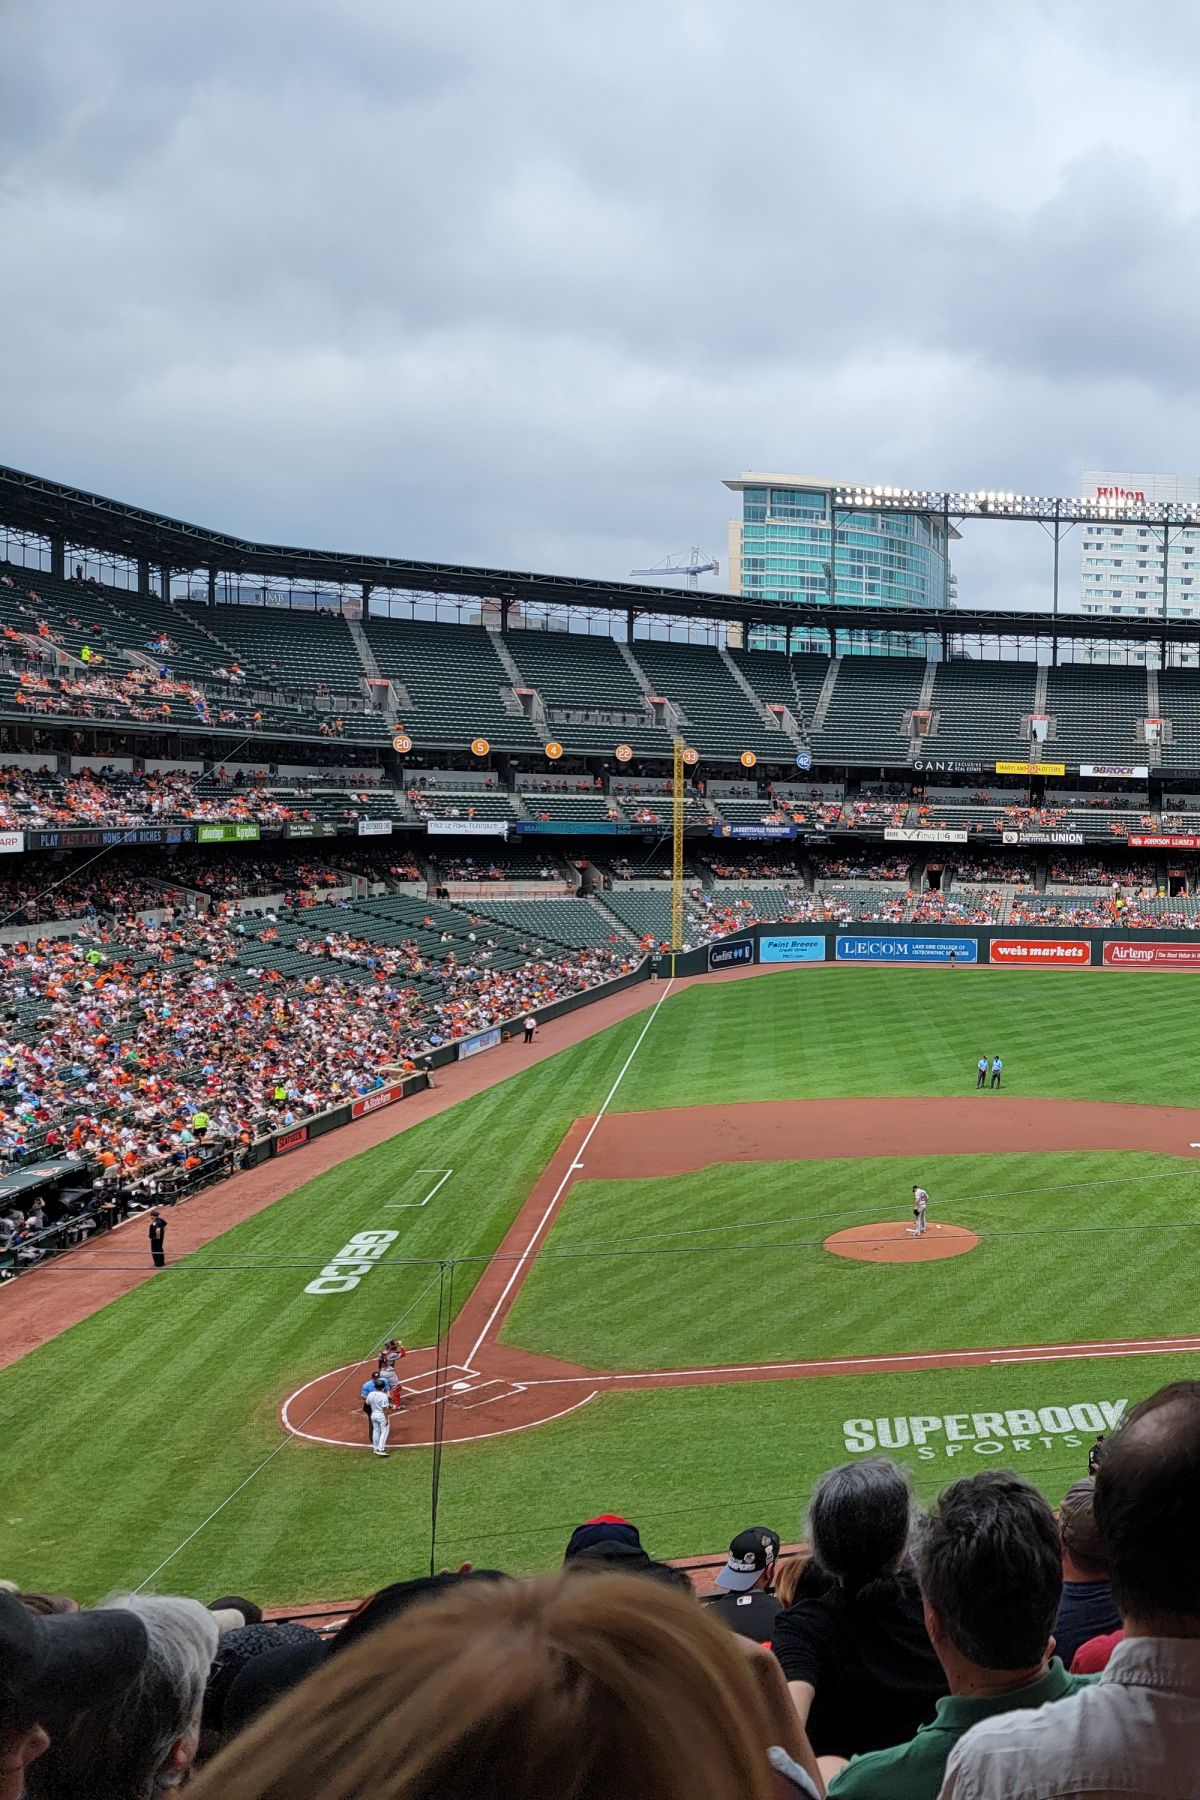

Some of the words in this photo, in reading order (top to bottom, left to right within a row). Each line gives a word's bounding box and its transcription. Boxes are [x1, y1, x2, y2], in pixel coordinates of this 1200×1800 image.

[1096, 486, 1145, 502] Hilton
[914, 760, 954, 771] GANZ
[999, 764, 1026, 772] MARYLAND
[40, 834, 59, 847] PLAY
[102, 832, 122, 844] HOME
[124, 831, 138, 843] RUN
[139, 830, 162, 843] RICHES
[1051, 833, 1083, 843] UNION
[1143, 838, 1170, 846] JOHNSON
[791, 941, 819, 949] Breeze
[997, 945, 1028, 956] weis
[1029, 946, 1084, 957] markets
[1111, 946, 1154, 962] Airtemp
[303, 1229, 400, 1295] GEICO
[917, 1434, 1084, 1460] SPORTS
